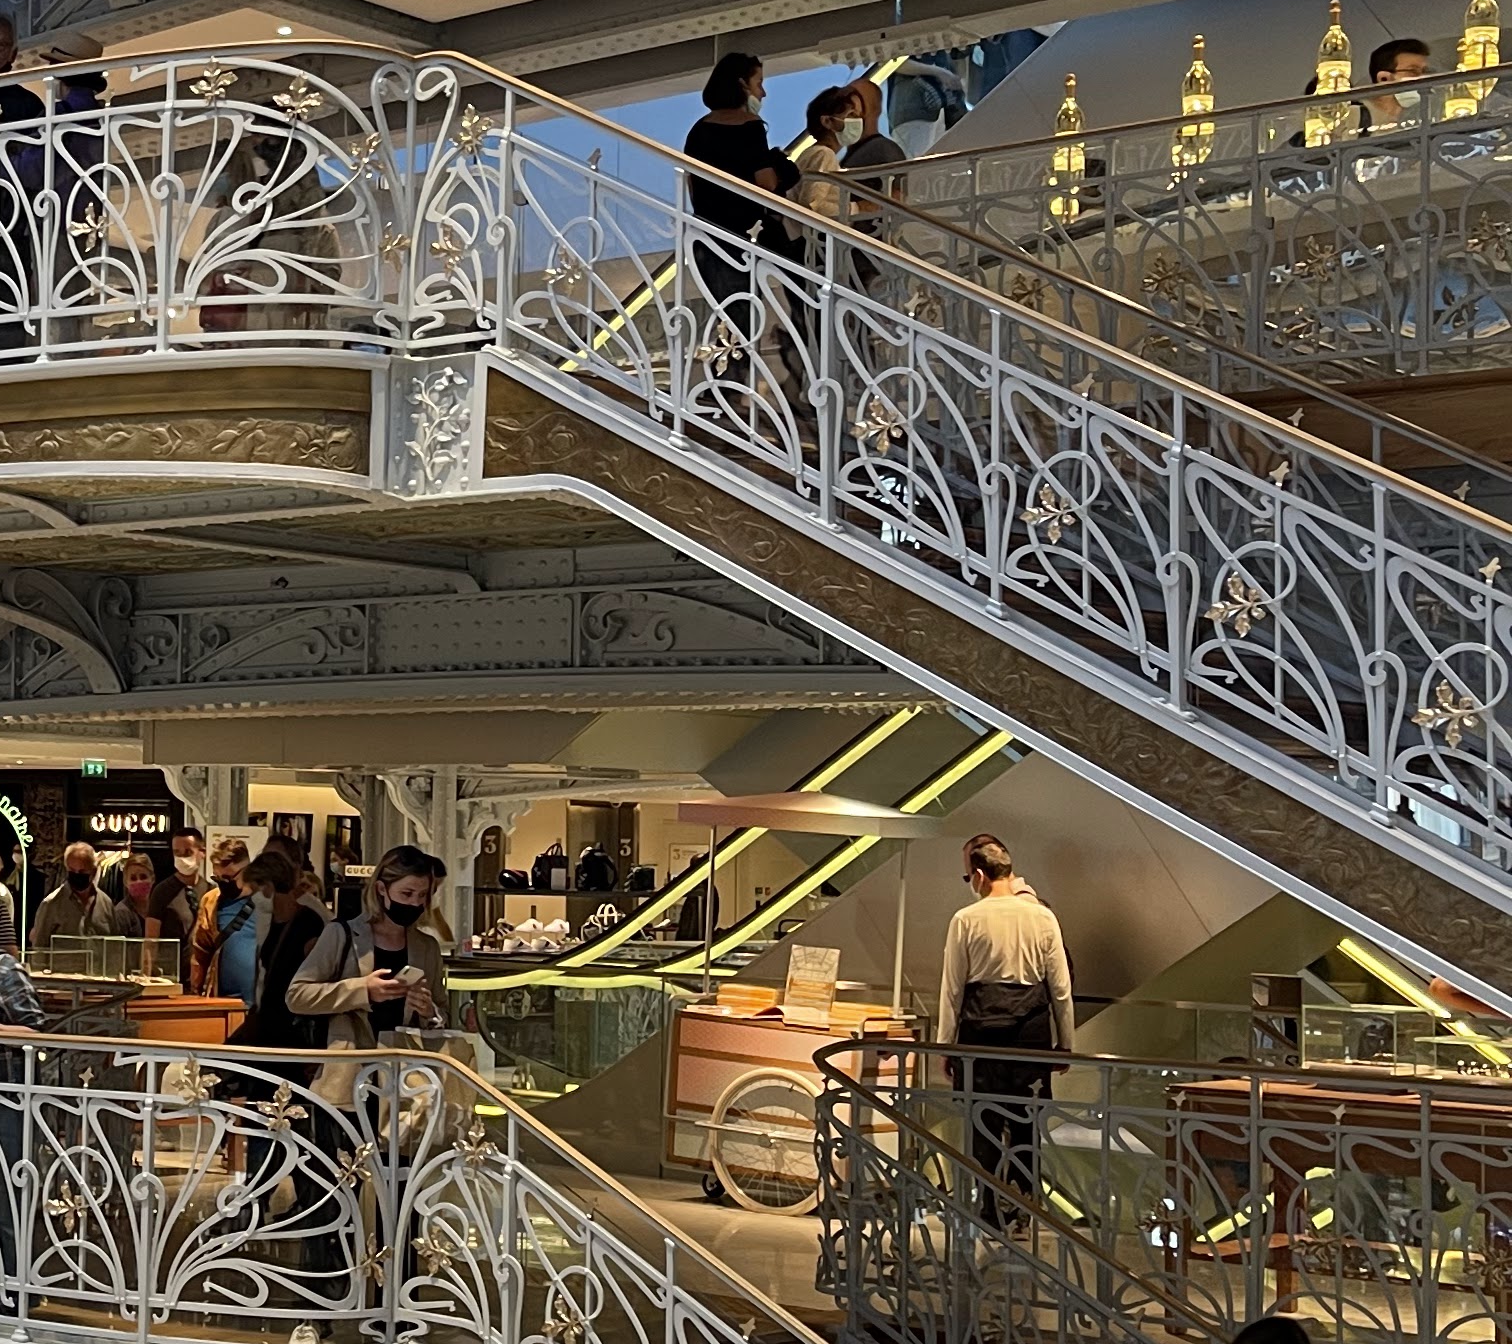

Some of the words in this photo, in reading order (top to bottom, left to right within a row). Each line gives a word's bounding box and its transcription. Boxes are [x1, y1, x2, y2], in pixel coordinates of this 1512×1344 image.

[91, 812, 166, 833] GUCCI
[484, 835, 497, 854] 3
[619, 838, 632, 857] 3
[346, 866, 373, 875] GUCC
